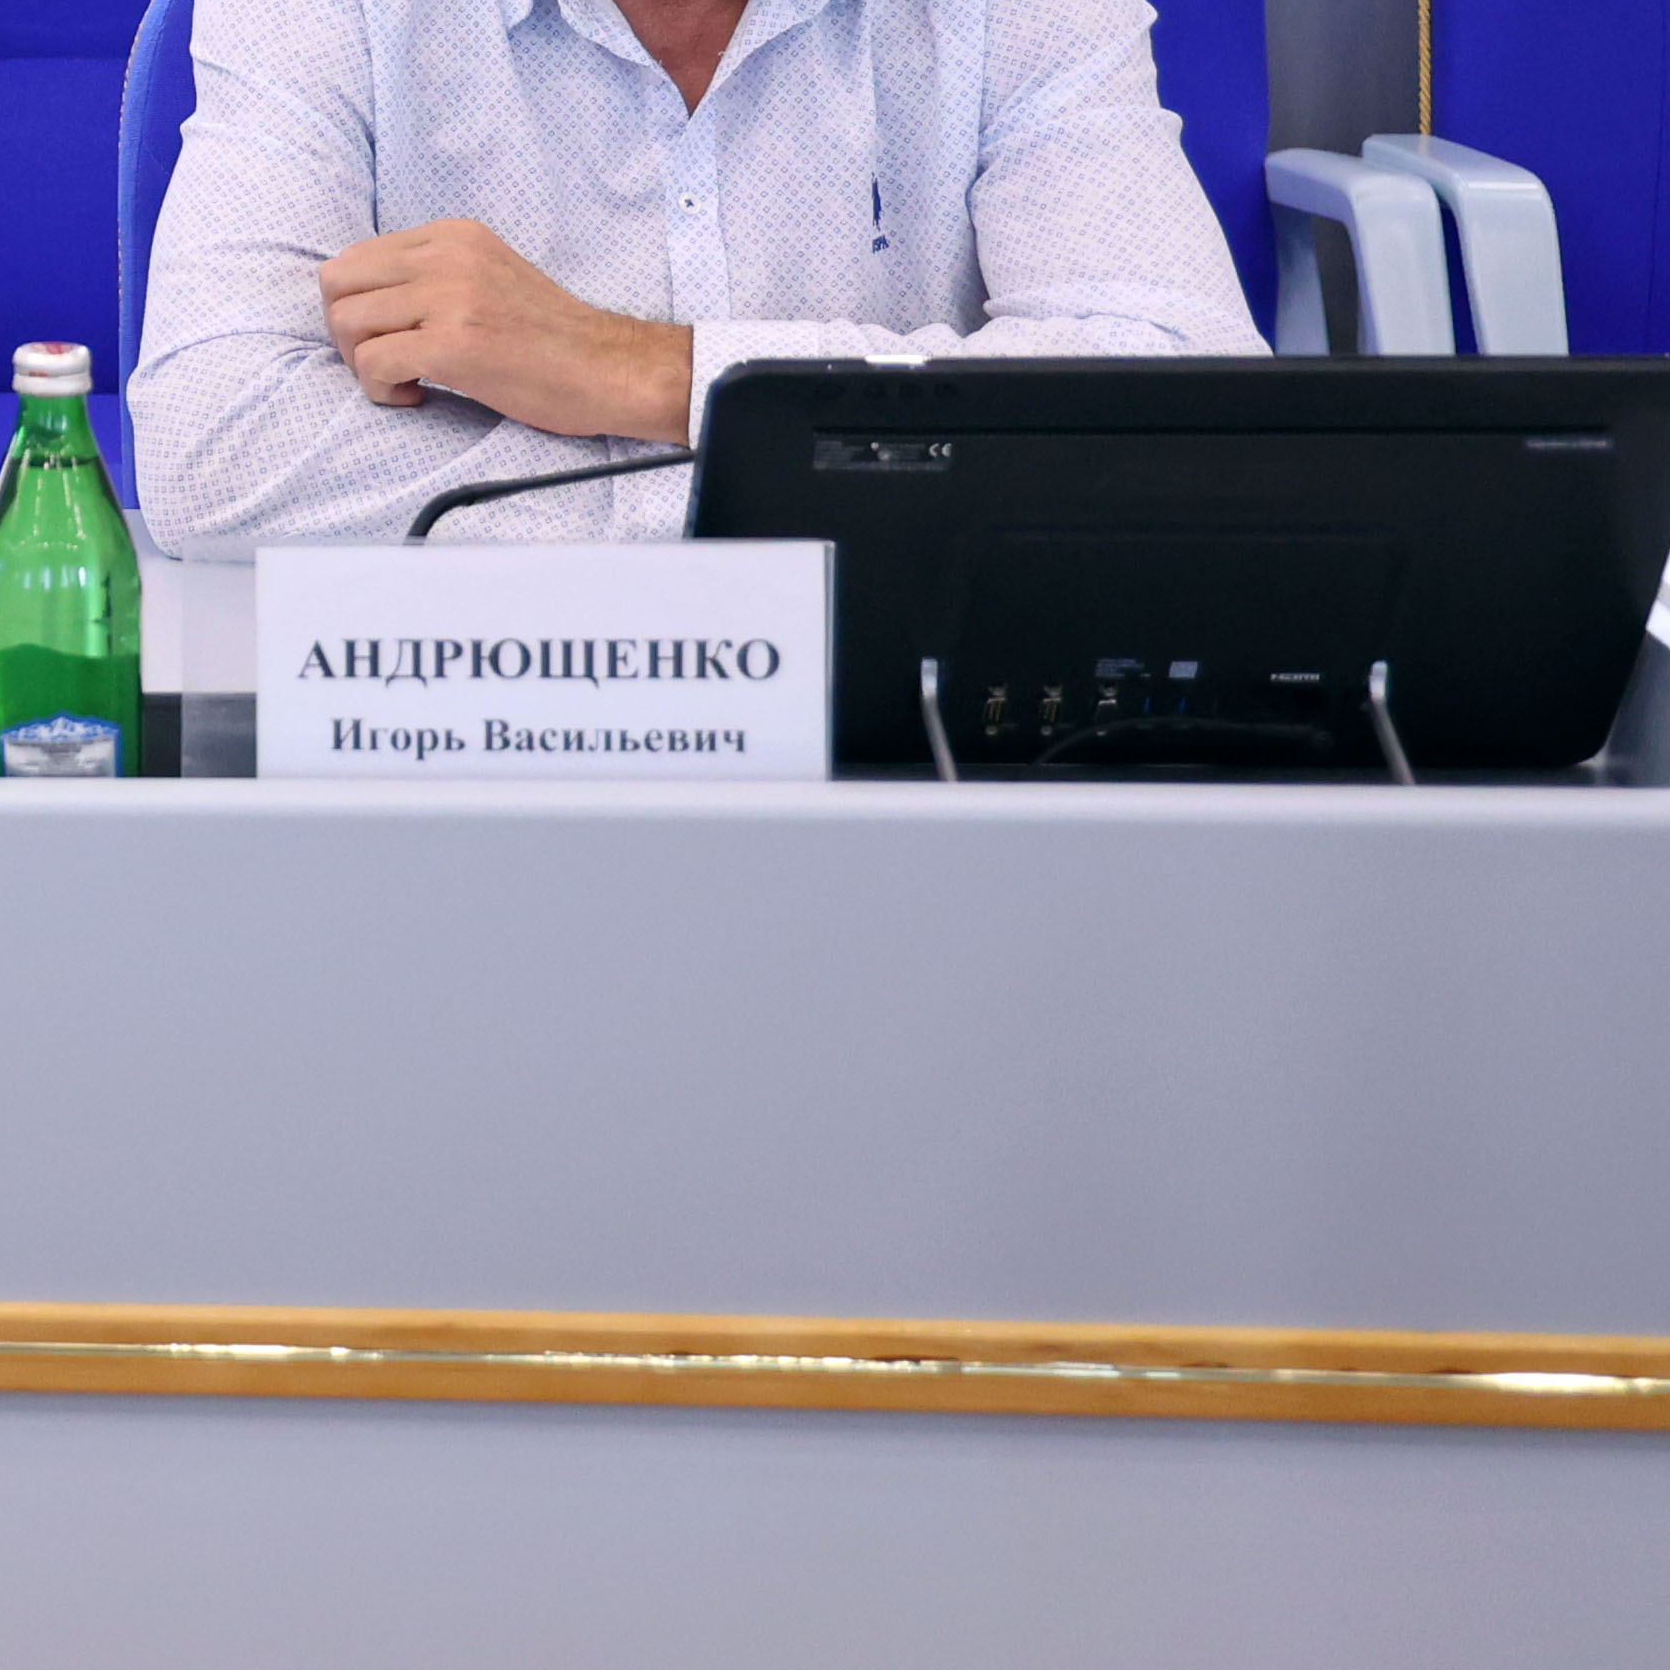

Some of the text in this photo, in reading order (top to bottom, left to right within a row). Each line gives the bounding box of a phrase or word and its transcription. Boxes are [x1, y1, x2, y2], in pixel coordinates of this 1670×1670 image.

[298, 638, 782, 688] АНДРЮЩЕНКО
[331, 718, 746, 761] Игорь Васильевич
